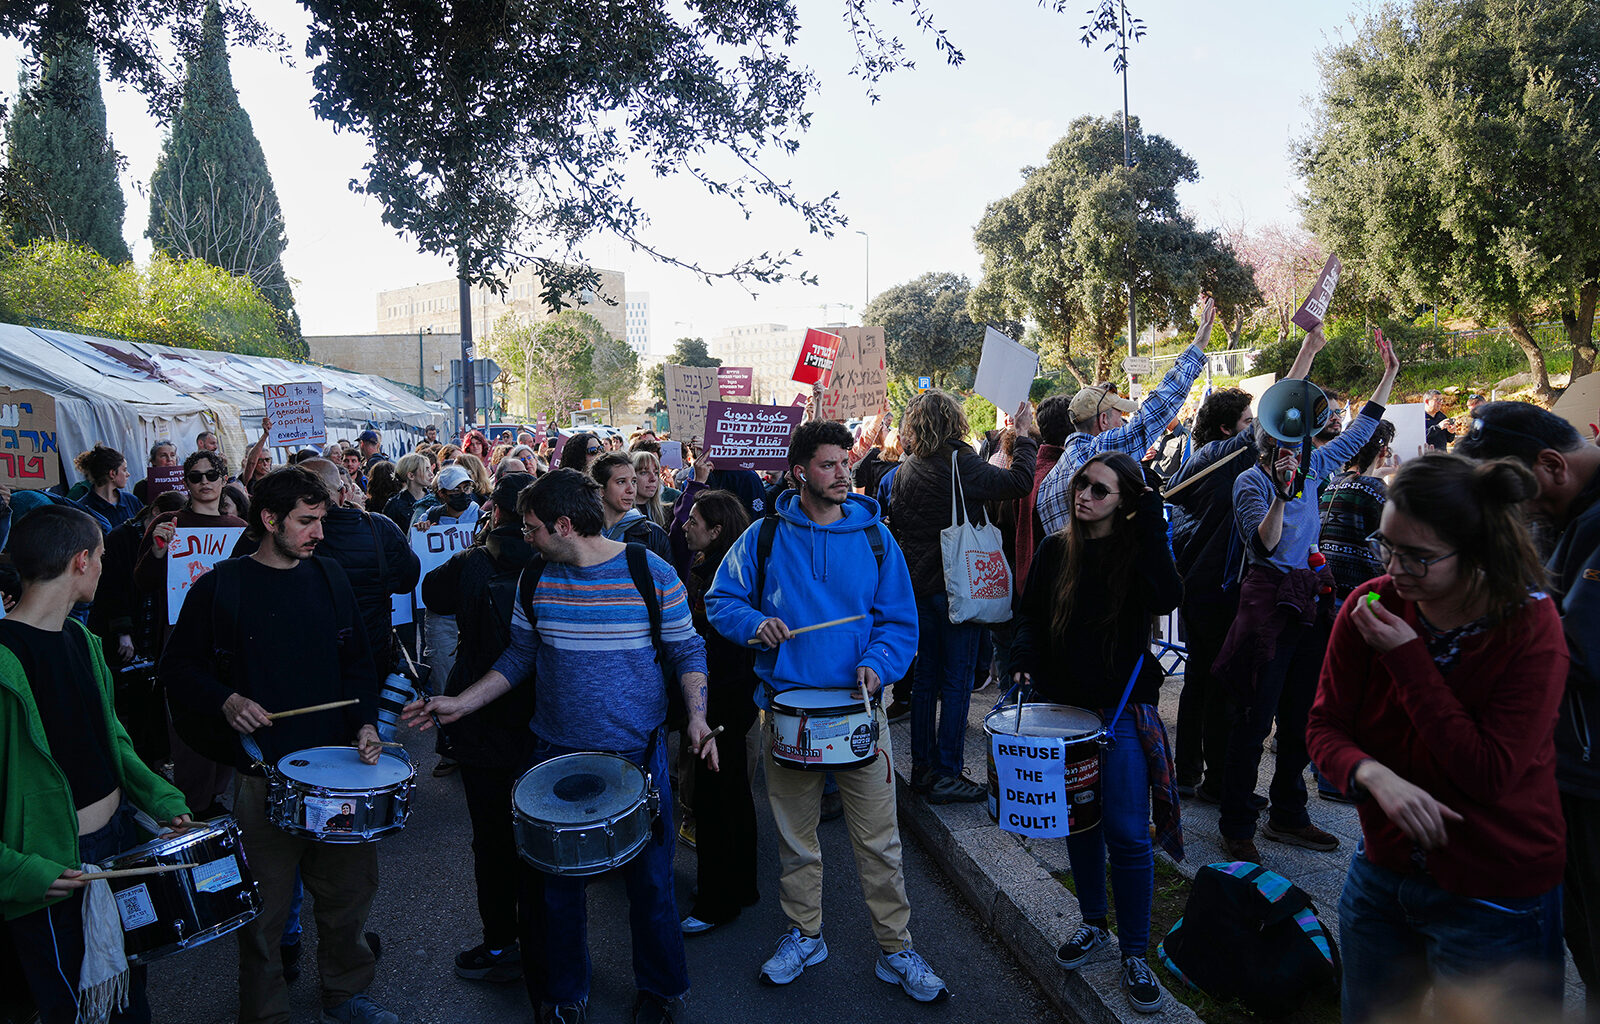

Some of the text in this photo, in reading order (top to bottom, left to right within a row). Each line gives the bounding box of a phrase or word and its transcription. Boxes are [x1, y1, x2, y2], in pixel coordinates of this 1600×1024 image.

[267, 385, 318, 397] NO to the
[274, 398, 310, 408] barbaric
[276, 406, 311, 418] genocidal
[724, 407, 788, 423] حكومة دموية
[278, 415, 314, 428] apartheid
[720, 422, 788, 433] ממשלת דמים
[277, 426, 323, 439] execution law
[756, 436, 783, 446] تقتلنا
[712, 446, 787, 456] הורגת את כולנו
[172, 534, 227, 558] מוות
[998, 744, 1060, 760] REFUSE
[1015, 768, 1043, 782] THE
[1006, 789, 1056, 805] DEATH
[1009, 813, 1056, 829] CULT!
